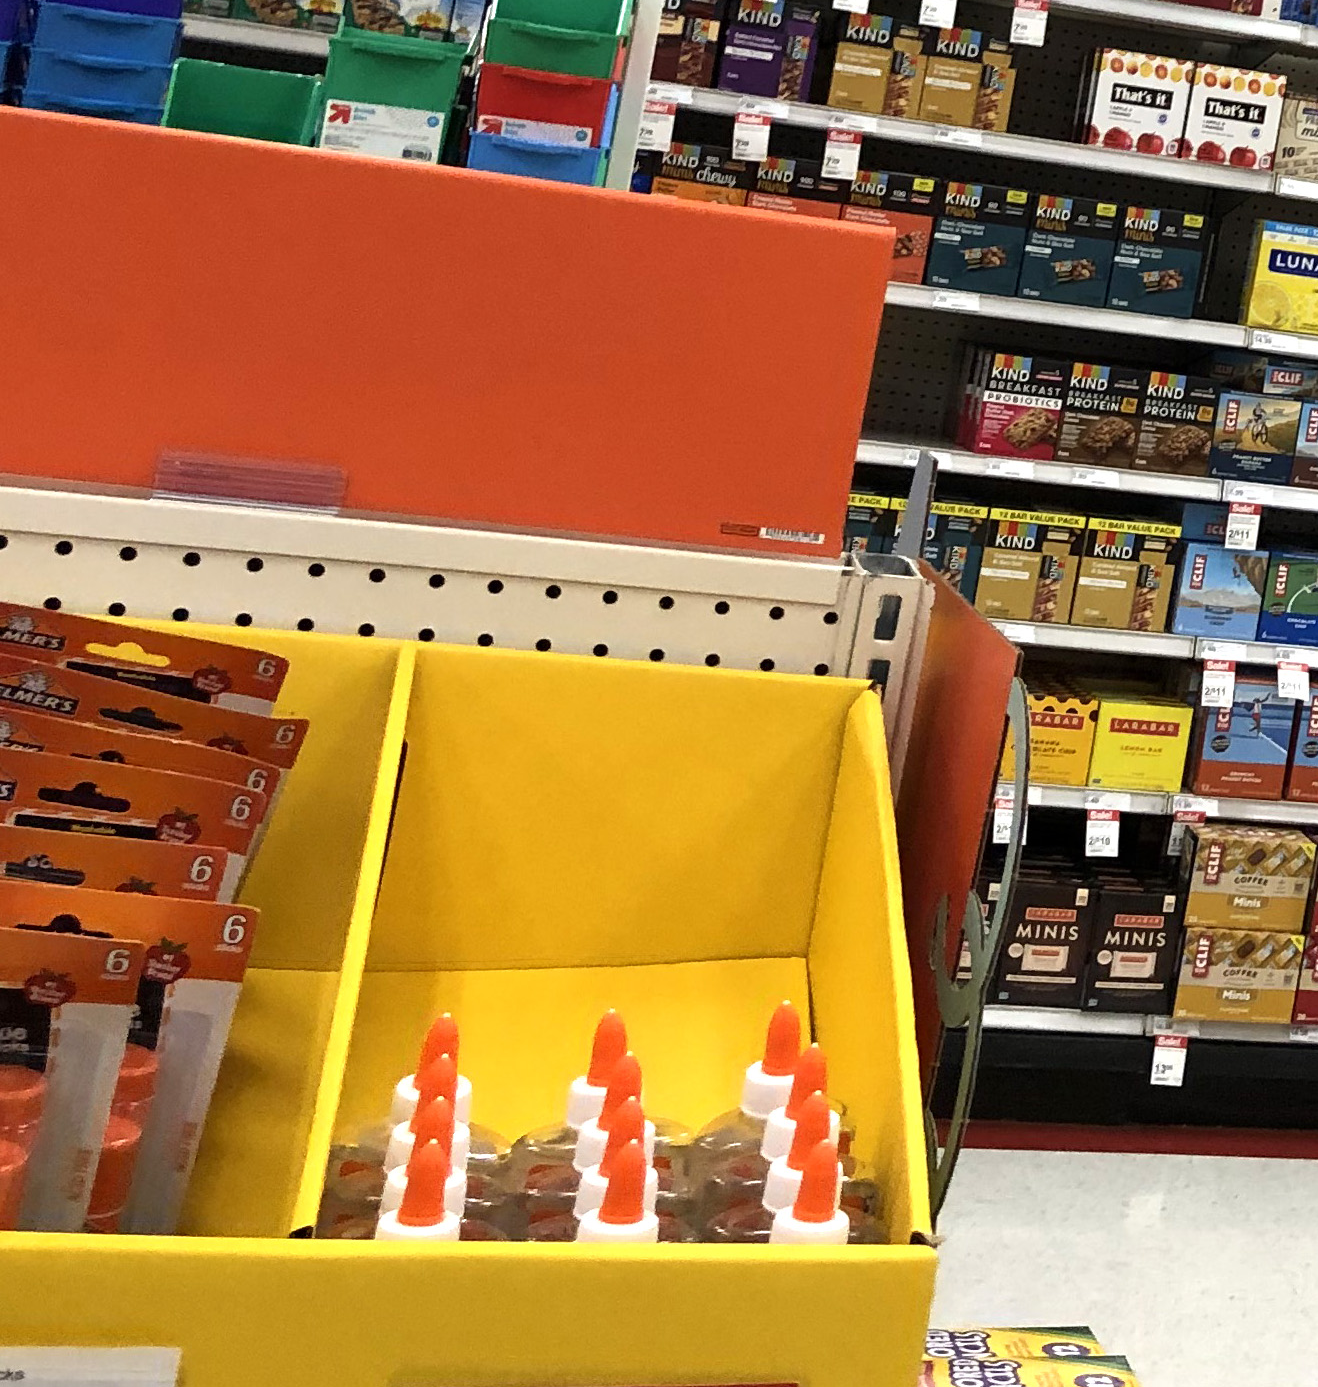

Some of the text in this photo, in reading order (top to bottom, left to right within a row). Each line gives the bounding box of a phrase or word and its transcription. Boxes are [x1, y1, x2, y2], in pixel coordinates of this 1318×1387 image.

[737, 9, 782, 27] KIND
[1114, 86, 1167, 107] That's it
[1208, 100, 1259, 120] That's it
[1282, 146, 1295, 158] 10
[945, 193, 981, 207] KIND
[991, 367, 1029, 382] KIND
[1278, 370, 1302, 384] CLIF
[989, 380, 1062, 397] BREAKFAST
[1069, 376, 1108, 391] KIND
[987, 393, 1060, 409] PROBIOTICS
[1066, 397, 1119, 411] PROTEIN
[1227, 400, 1239, 425] CLIF
[1010, 512, 1027, 520] BAR
[1029, 514, 1055, 523] VALUE
[1058, 516, 1080, 526] PACK
[996, 535, 1035, 549] KIND
[1193, 556, 1206, 582] CLIF
[258, 660, 276, 677] 6
[1113, 719, 1175, 734] LARABAR
[1208, 843, 1223, 873] CLIF
[1234, 876, 1268, 887] COFFEE
[1233, 897, 1261, 908] Minis
[1016, 924, 1079, 941] MINIS
[1105, 931, 1166, 947] MINIS
